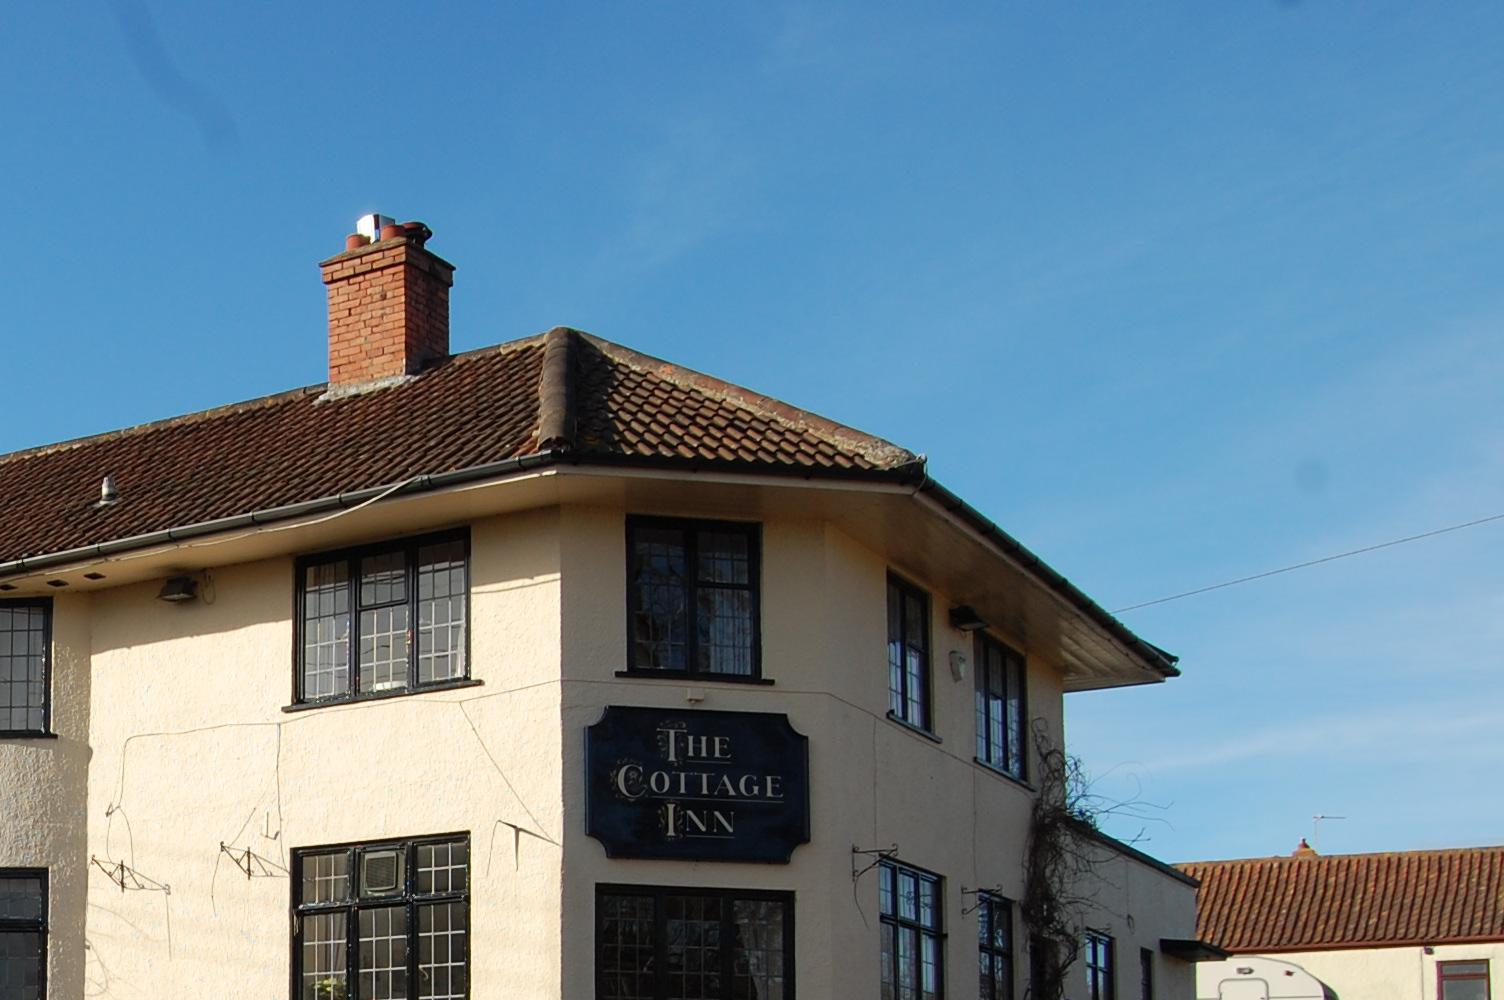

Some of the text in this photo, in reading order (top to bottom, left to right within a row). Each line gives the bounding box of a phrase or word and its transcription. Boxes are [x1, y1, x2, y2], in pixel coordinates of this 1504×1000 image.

[656, 726, 732, 763] THE
[617, 764, 784, 800] COTTAGE
[665, 803, 735, 837] INN
